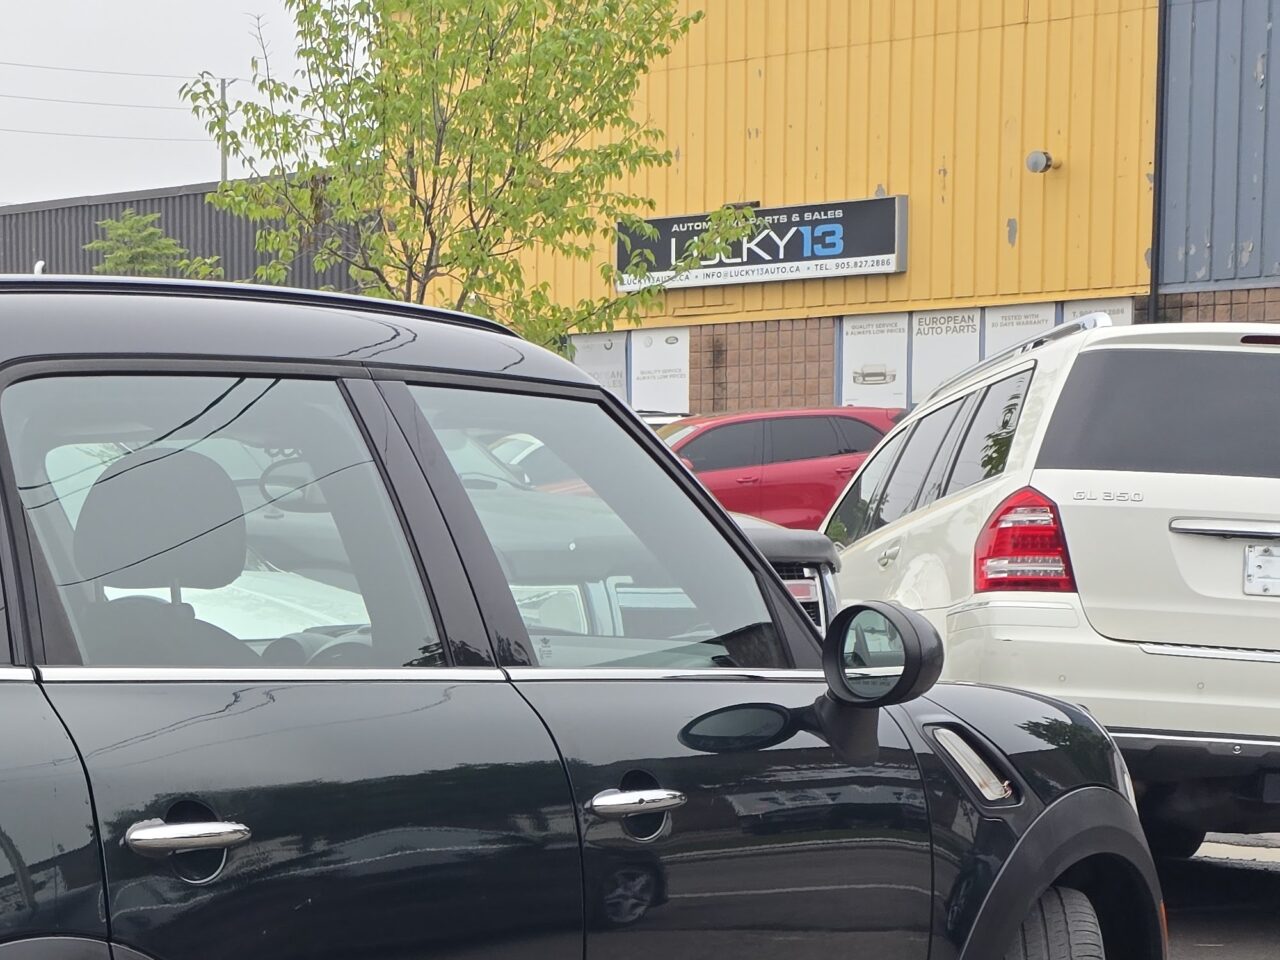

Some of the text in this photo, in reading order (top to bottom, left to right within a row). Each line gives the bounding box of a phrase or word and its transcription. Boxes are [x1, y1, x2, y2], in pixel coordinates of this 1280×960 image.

[749, 214, 788, 226] PARTS
[791, 213, 800, 222] &
[804, 209, 843, 221] SALES
[814, 262, 832, 272] TEL.
[835, 258, 891, 270] 905.827.2886
[917, 315, 975, 327] EUROPEAN
[916, 324, 977, 336] AUTO PARTS
[1073, 489, 1144, 503] GL 350
